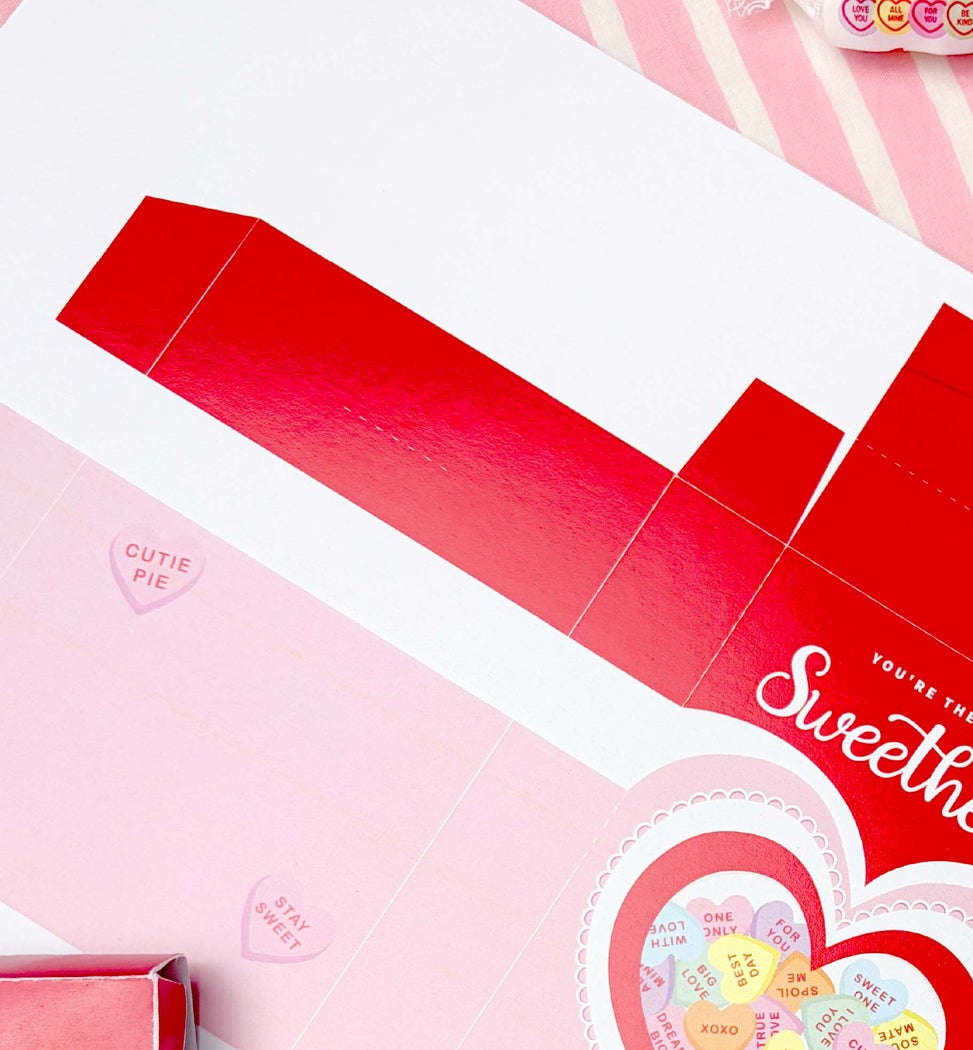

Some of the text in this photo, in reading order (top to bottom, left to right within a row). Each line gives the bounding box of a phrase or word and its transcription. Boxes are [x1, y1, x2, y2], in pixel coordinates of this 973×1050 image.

[852, 5, 869, 13] LOVE
[125, 543, 192, 573] CUTIE
[133, 568, 169, 590] PIE
[871, 652, 938, 700] YOU'RE
[275, 896, 310, 931] STAY
[704, 911, 734, 922] ONE
[255, 902, 302, 950] SWEET
[649, 921, 685, 934] LOVE
[775, 918, 801, 942] FOR
[651, 935, 687, 948] WITH
[767, 928, 791, 952] YOU
[697, 964, 717, 987] BIG
[727, 954, 748, 987] BEST
[743, 953, 759, 977] DAY
[681, 968, 710, 1000] LOVE
[787, 972, 807, 983] ME
[777, 986, 819, 998] SPOIL
[854, 974, 897, 1006] SWEET
[854, 991, 880, 1013] ONE
[701, 1024, 739, 1036] XOXO
[755, 1012, 766, 1049] TRUE
[770, 1012, 780, 1037] OVE
[815, 1007, 838, 1033] YOU
[821, 1015, 849, 1047] LOVE
[879, 1022, 915, 1042] MATE
[892, 1036, 919, 1050] SOU
